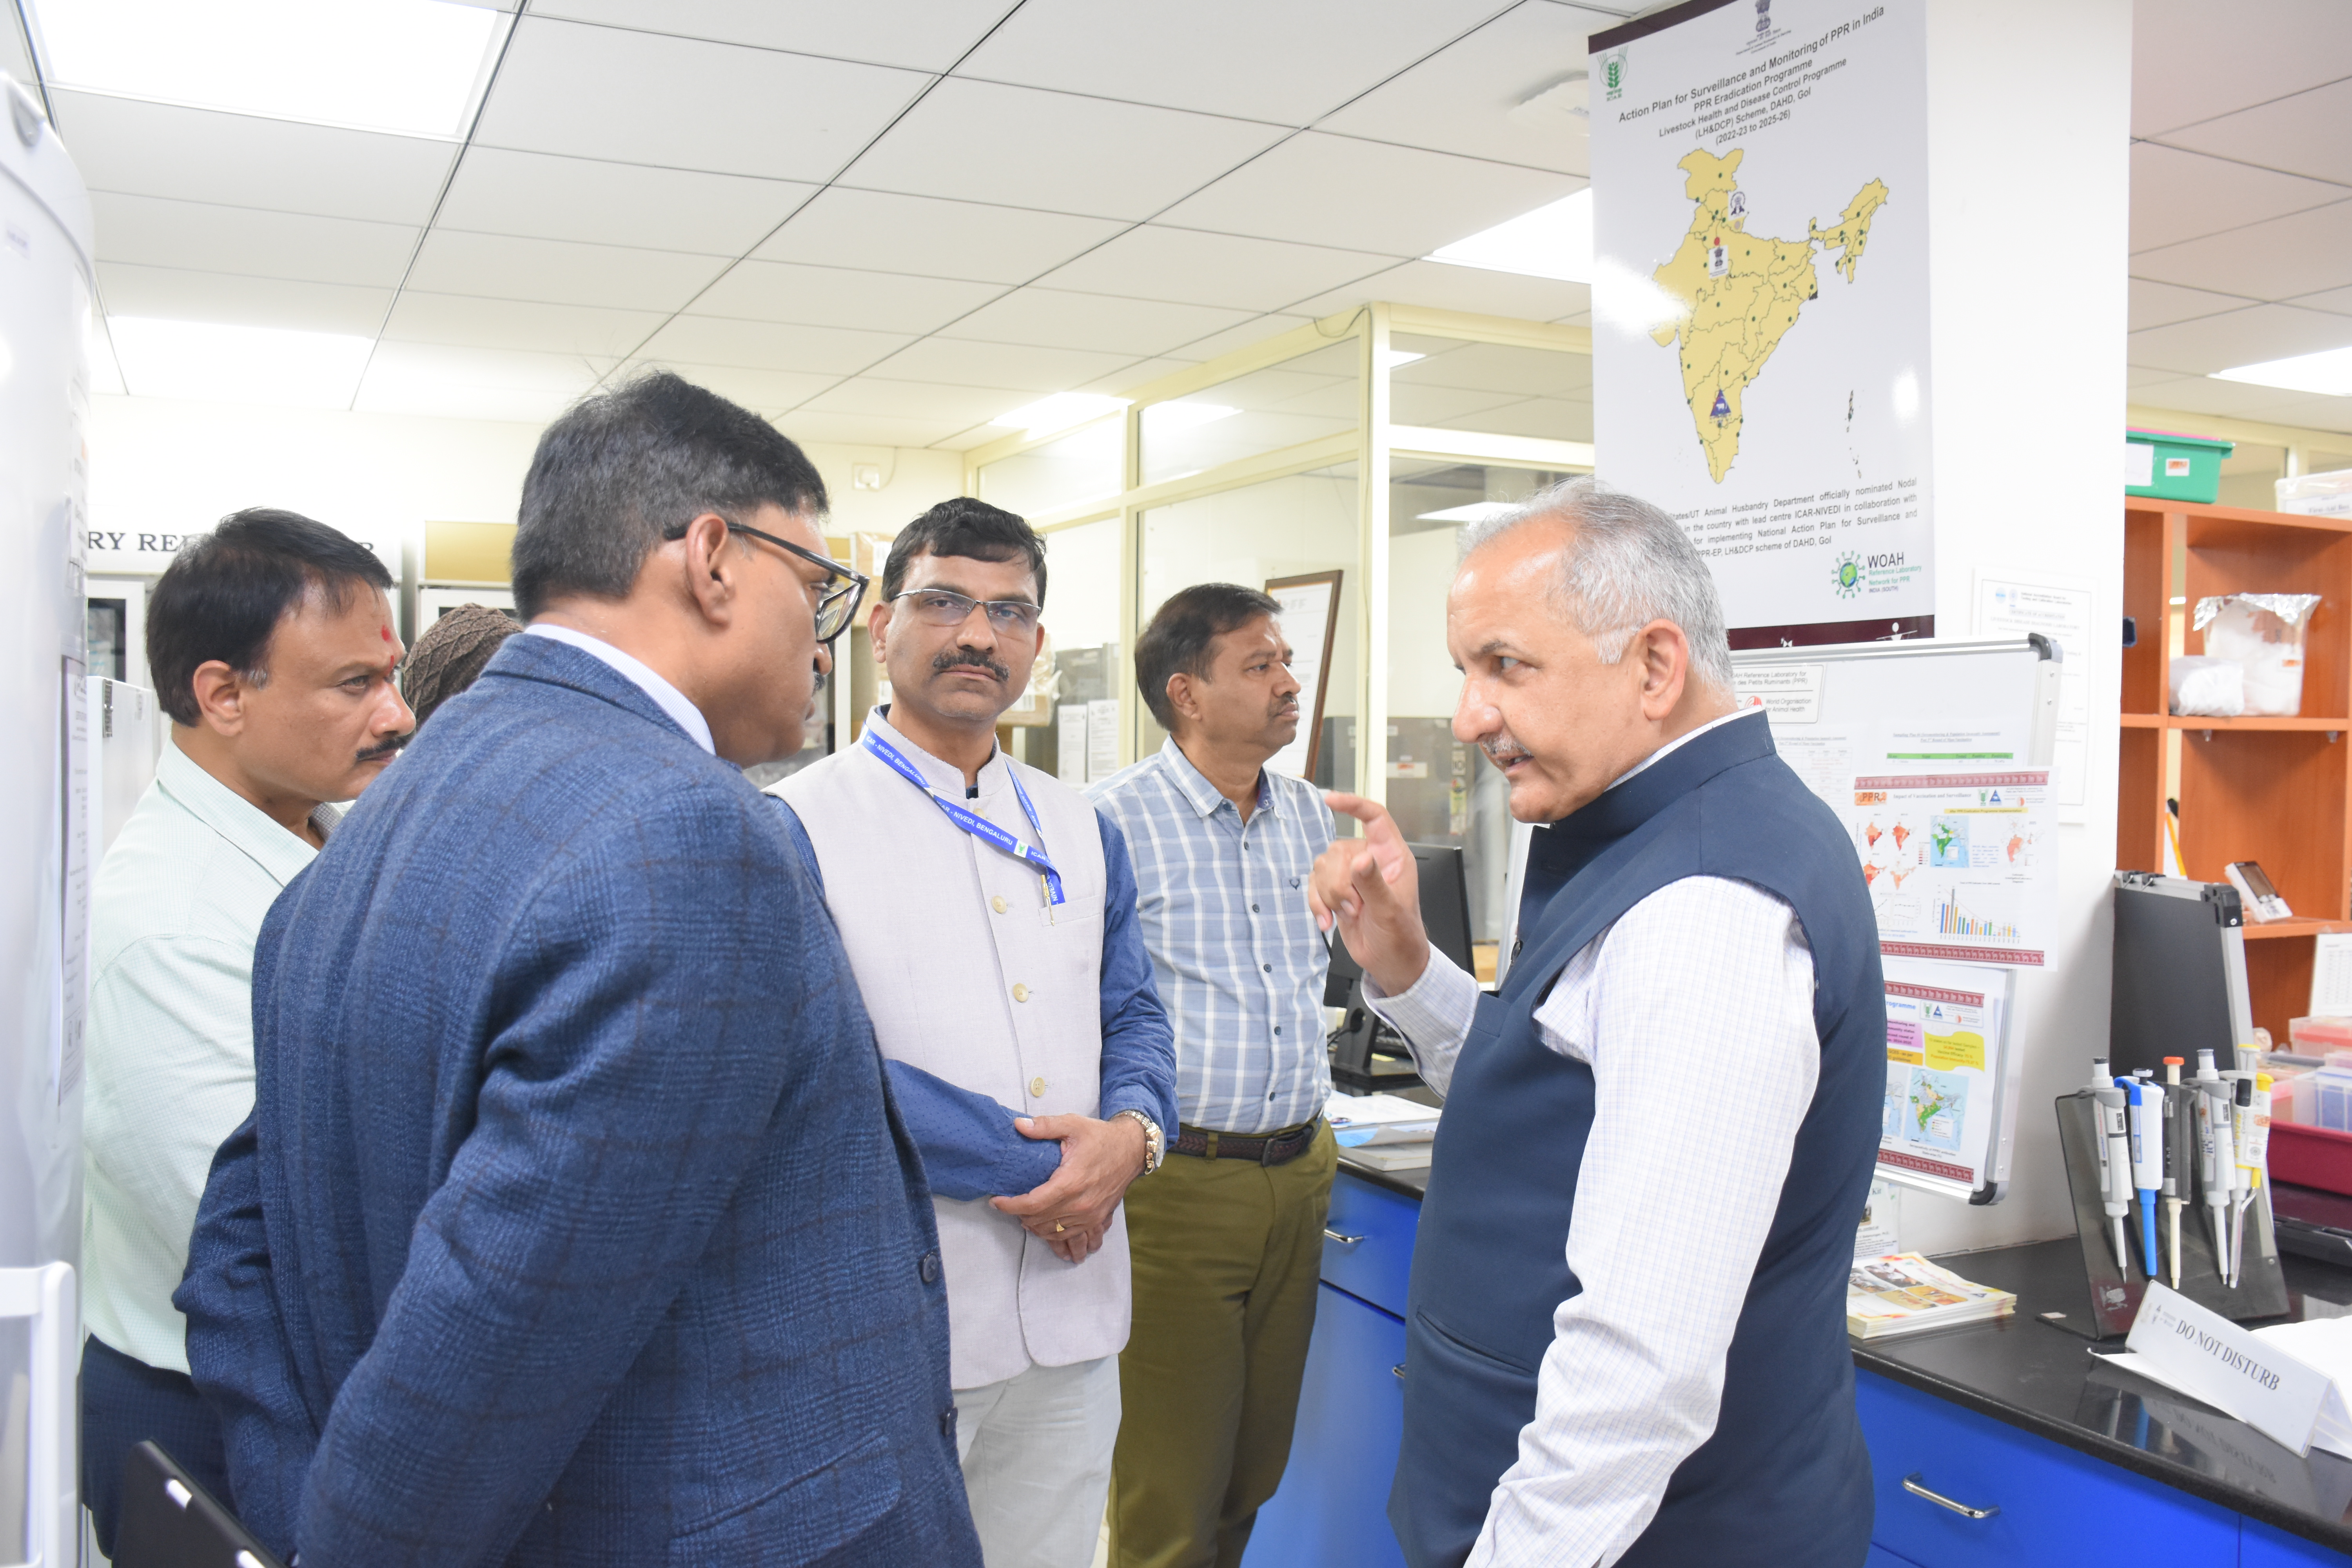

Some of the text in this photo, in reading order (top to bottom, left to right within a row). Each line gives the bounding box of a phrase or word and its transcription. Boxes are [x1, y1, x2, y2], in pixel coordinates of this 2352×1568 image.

[1619, 107, 1649, 123] Action
[1652, 100, 1672, 112] Plan
[1675, 93, 1688, 104] for
[1691, 72, 1747, 99] Surveillance
[1749, 63, 1766, 77] and
[1769, 41, 1818, 69] Monitoring
[1819, 33, 1828, 47] of
[1831, 23, 1850, 42] PPR
[1852, 19, 1860, 31] in
[1863, 6, 1884, 25] India
[1659, 58, 1847, 137] Livestock Health and Disease Control Programme
[1694, 59, 1813, 112] PPR Eradication Programme
[1695, 118, 1734, 140] (LH&DCP)
[1736, 106, 1768, 124] Scheme,
[1770, 94, 1796, 111] DAHD,
[1715, 109, 1791, 145] (2022-23 to 2025-26)
[1670, 477, 1917, 521] tates/UT Animal Husbandry Department officially nominated Nodal
[1707, 521, 1732, 530] country
[1735, 517, 1749, 526] with
[1752, 515, 1766, 524] lead
[1770, 513, 1791, 522] centre
[1795, 505, 1841, 518] ICAR-NIVEDI
[1854, 497, 1900, 511] collaboration
[1903, 493, 1917, 503] with
[138, 533, 186, 552] RE
[1708, 532, 1753, 544] implementing
[1758, 527, 1786, 537] National
[1791, 525, 1815, 534] Action
[1820, 521, 1836, 530] Plan
[1842, 519, 1851, 527] for
[1857, 513, 1900, 526] Surveillance
[1905, 509, 1917, 519] and
[1725, 544, 1754, 555] LH&DCP
[1756, 541, 1782, 552] scheme
[1784, 540, 1791, 548] of
[1793, 537, 1817, 548] DAHD,
[1867, 552, 1904, 568] WOAH
[1896, 566, 1922, 574] Laboratory
[866, 735, 877, 746] ICAR
[877, 744, 895, 760] NIVEDI,
[894, 757, 926, 785] BENGALURU
[1862, 792, 1880, 802] PPR
[953, 811, 975, 827] NIVEDI,
[976, 822, 1013, 846] BENGALURU
[1031, 851, 1046, 861] ICAR
[1886, 1001, 1916, 1010] rogramme
[2176, 1319, 2280, 1391] DO NOT DISTURB
